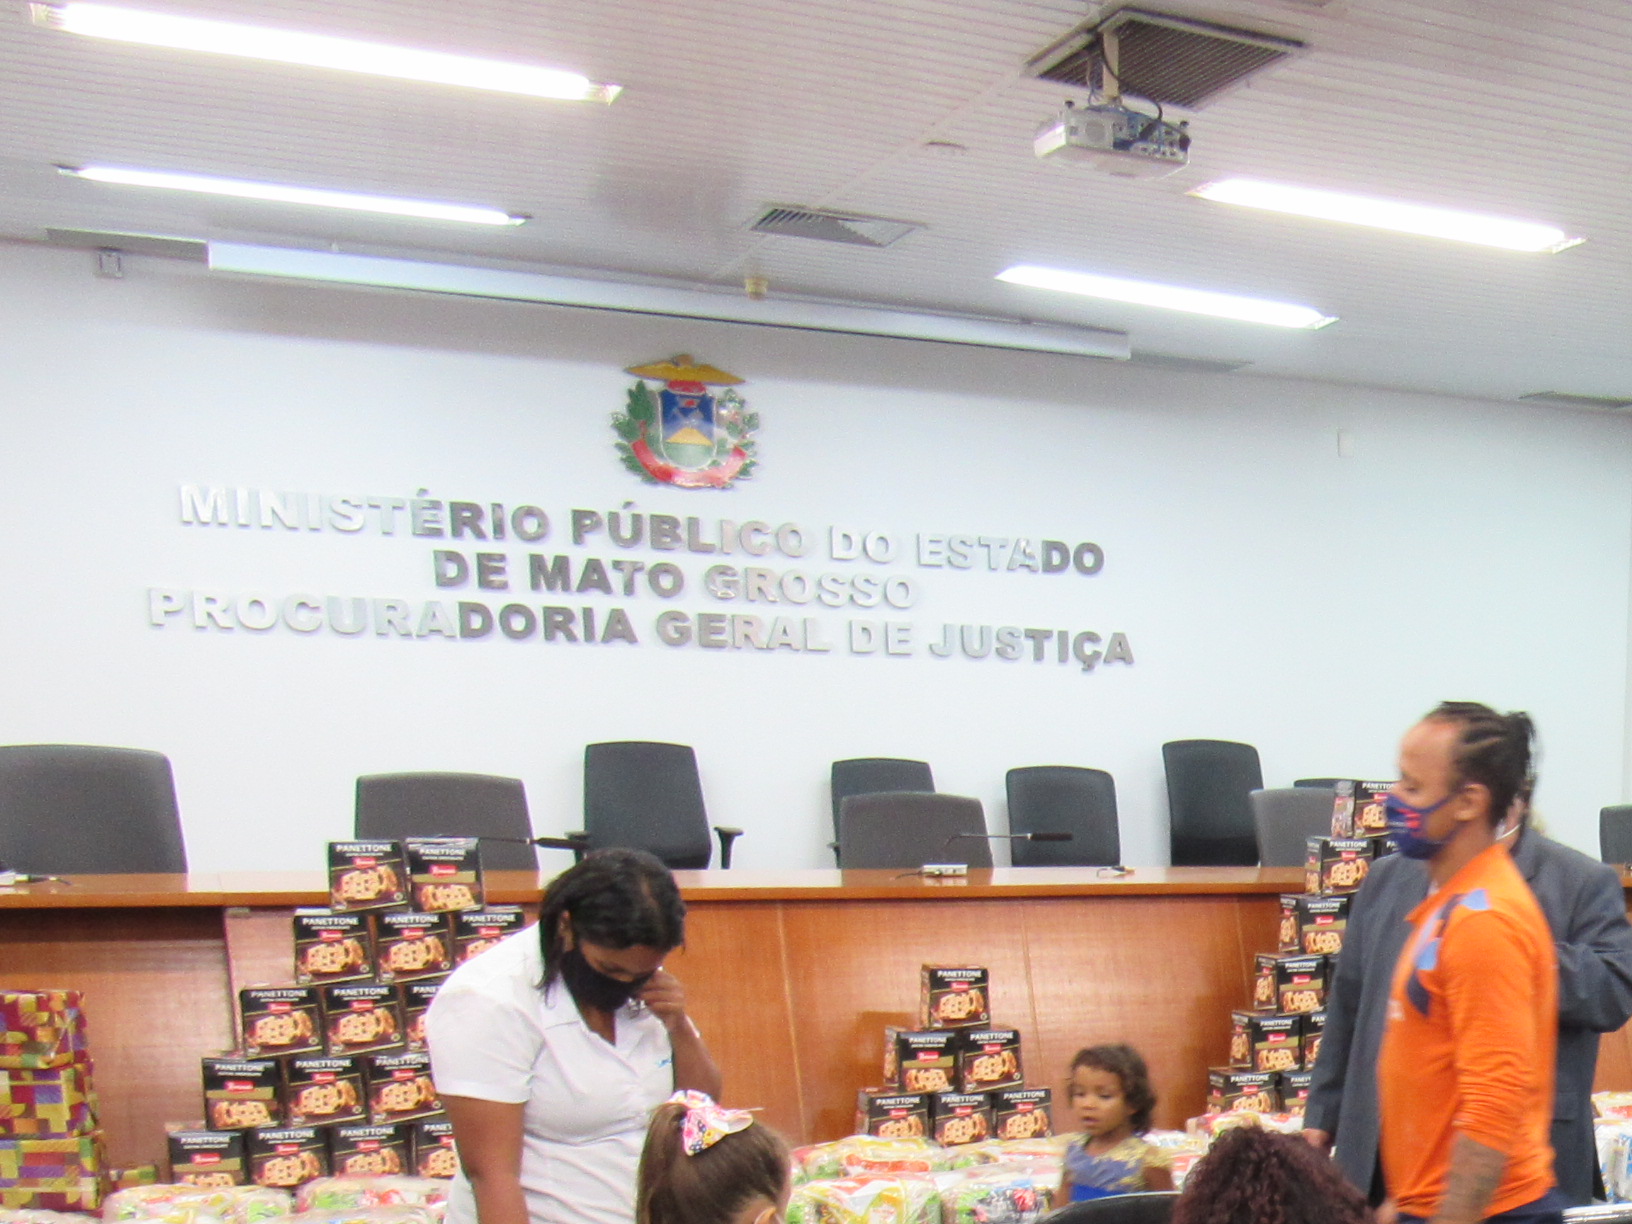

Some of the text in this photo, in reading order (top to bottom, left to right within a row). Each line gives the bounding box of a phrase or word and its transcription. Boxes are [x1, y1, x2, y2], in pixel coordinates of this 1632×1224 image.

[179, 488, 1105, 576] MINISTÉRIO PÚBLICO DO ESTADO
[433, 549, 918, 609] DE MATO GROSSO
[148, 586, 1135, 673] PROCURADORIA GERAL DE JUSTIÇA
